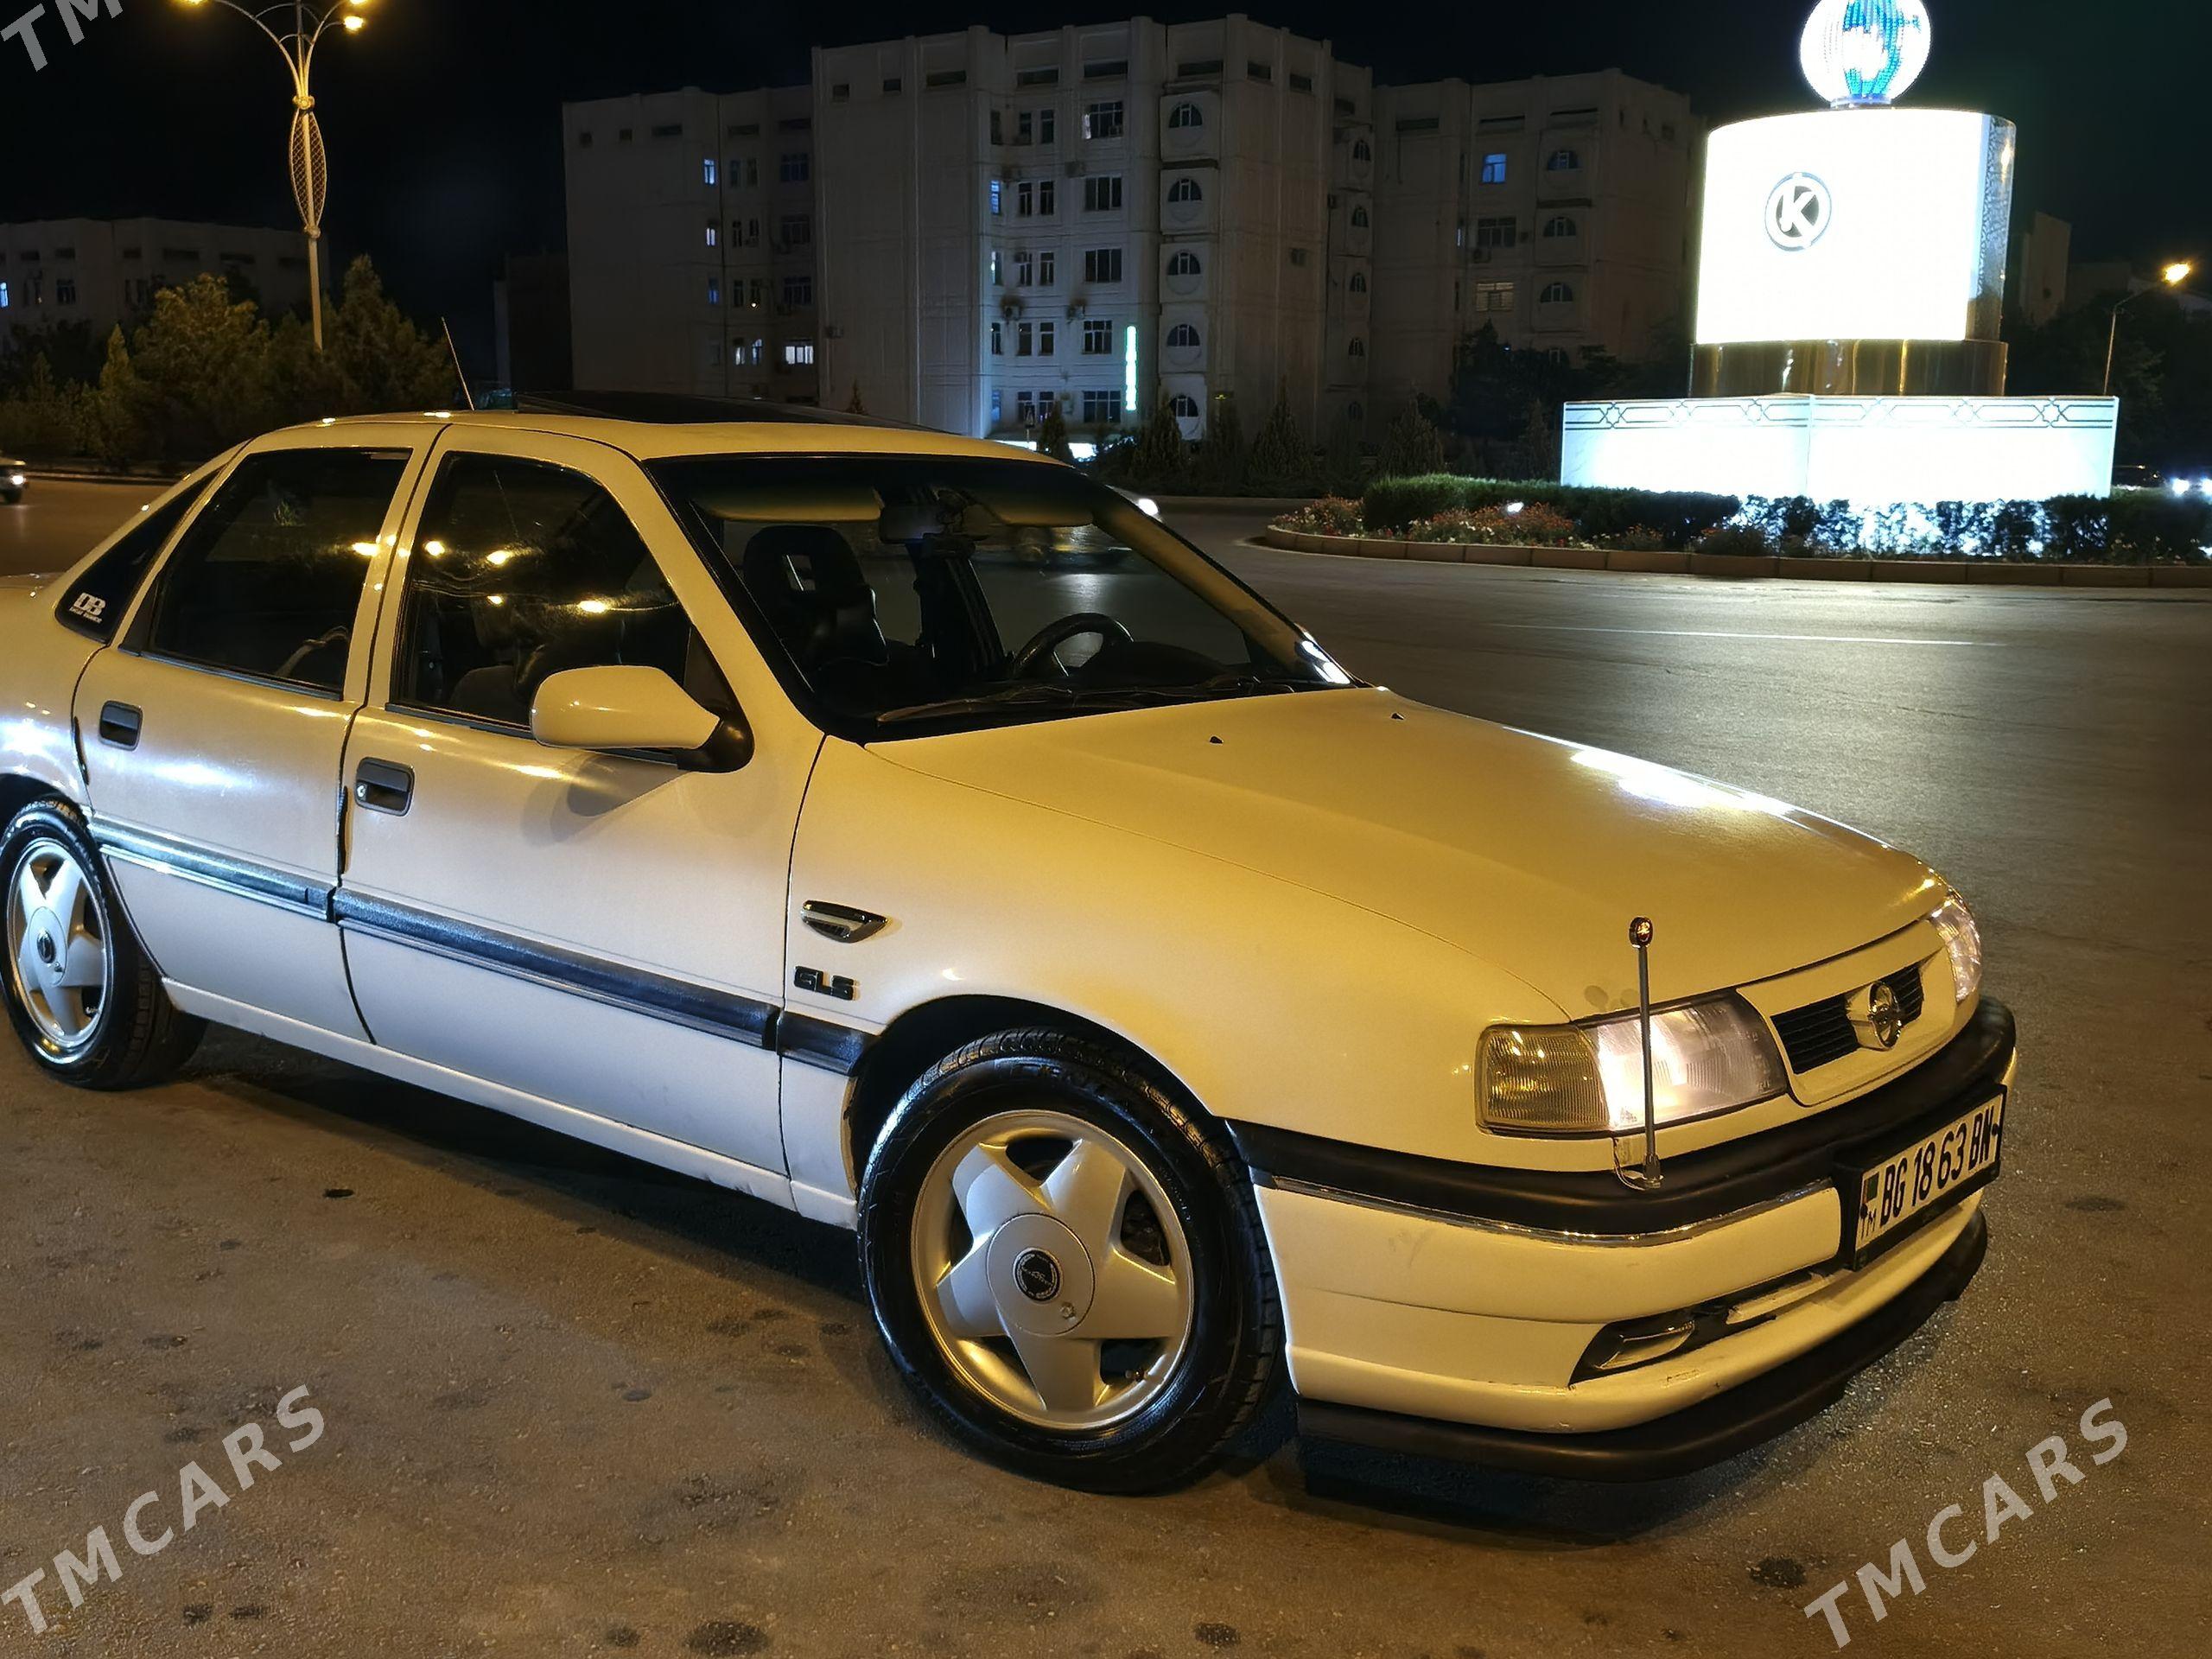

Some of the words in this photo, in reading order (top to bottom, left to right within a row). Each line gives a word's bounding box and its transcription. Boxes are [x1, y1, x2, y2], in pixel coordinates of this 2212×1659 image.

[1773, 175, 1821, 247] K
[1880, 1157, 1908, 1227] BG
[1912, 1141, 1936, 1207] 18
[1937, 1122, 1967, 1189] 63
